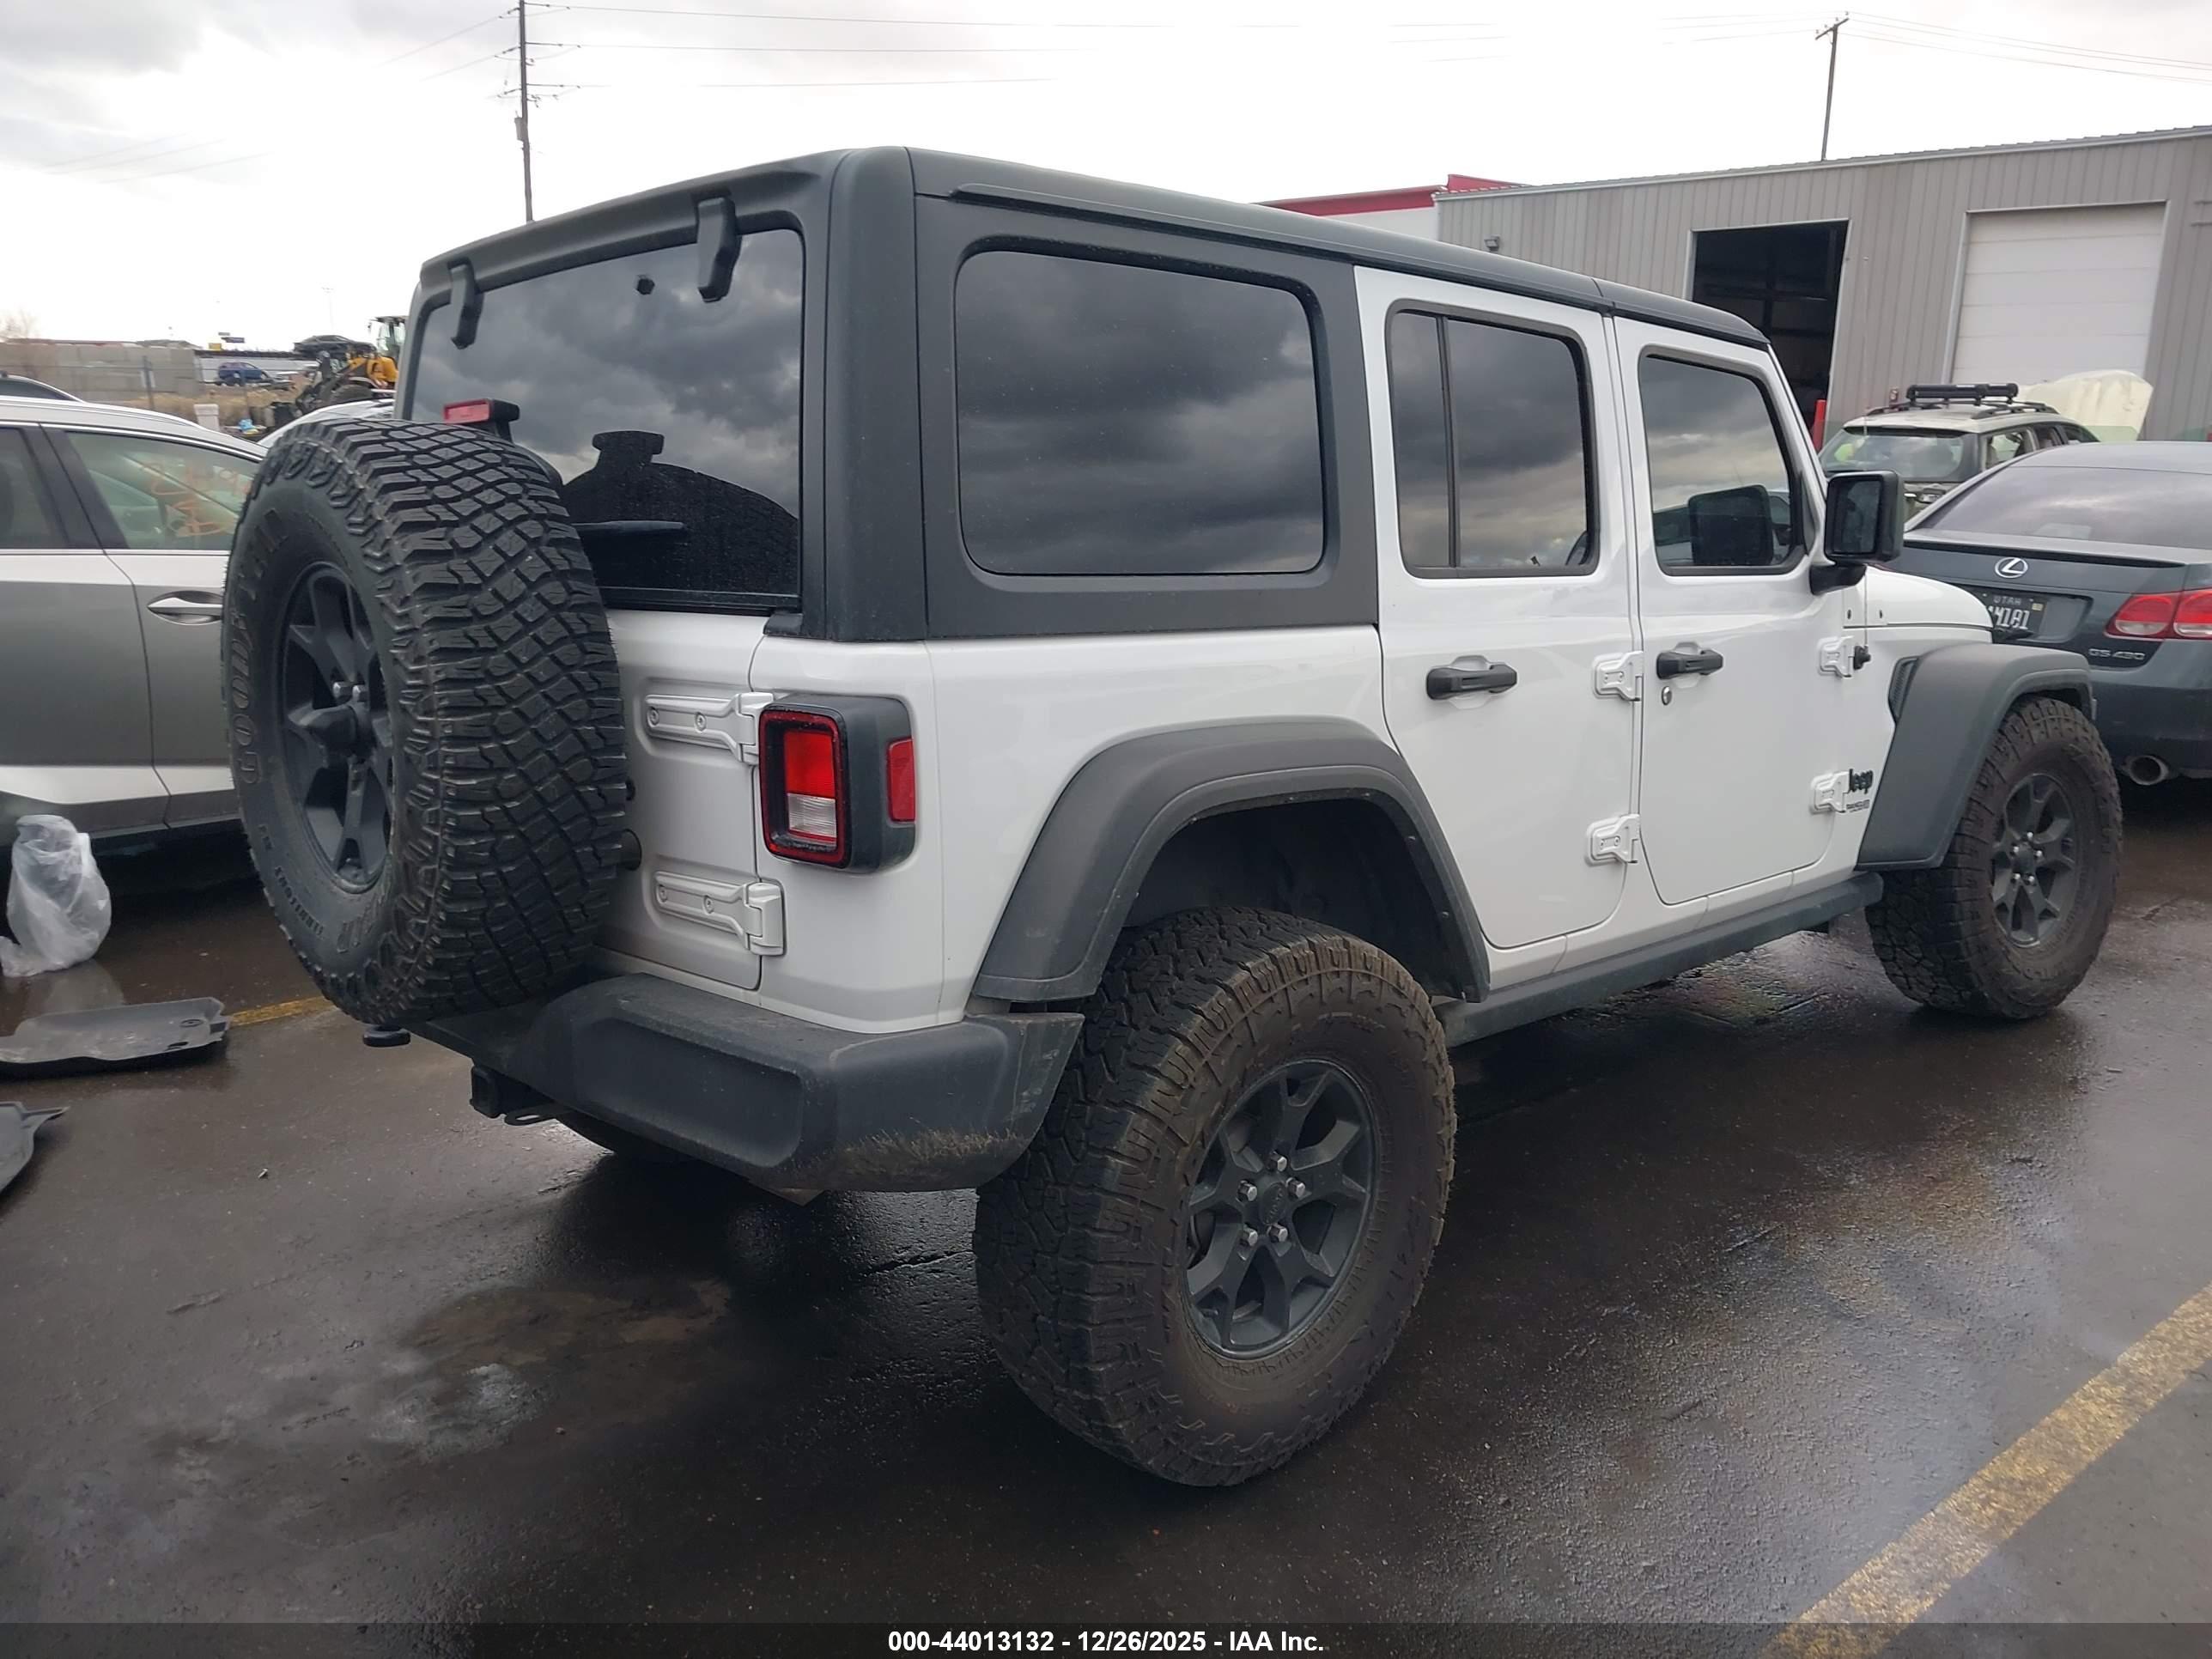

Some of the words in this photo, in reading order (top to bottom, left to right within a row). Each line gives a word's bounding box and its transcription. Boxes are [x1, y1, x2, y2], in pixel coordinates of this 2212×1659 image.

[1993, 595, 2021, 605] UTAH
[2088, 648, 2112, 658] GS
[1849, 768, 1874, 794] Jeep
